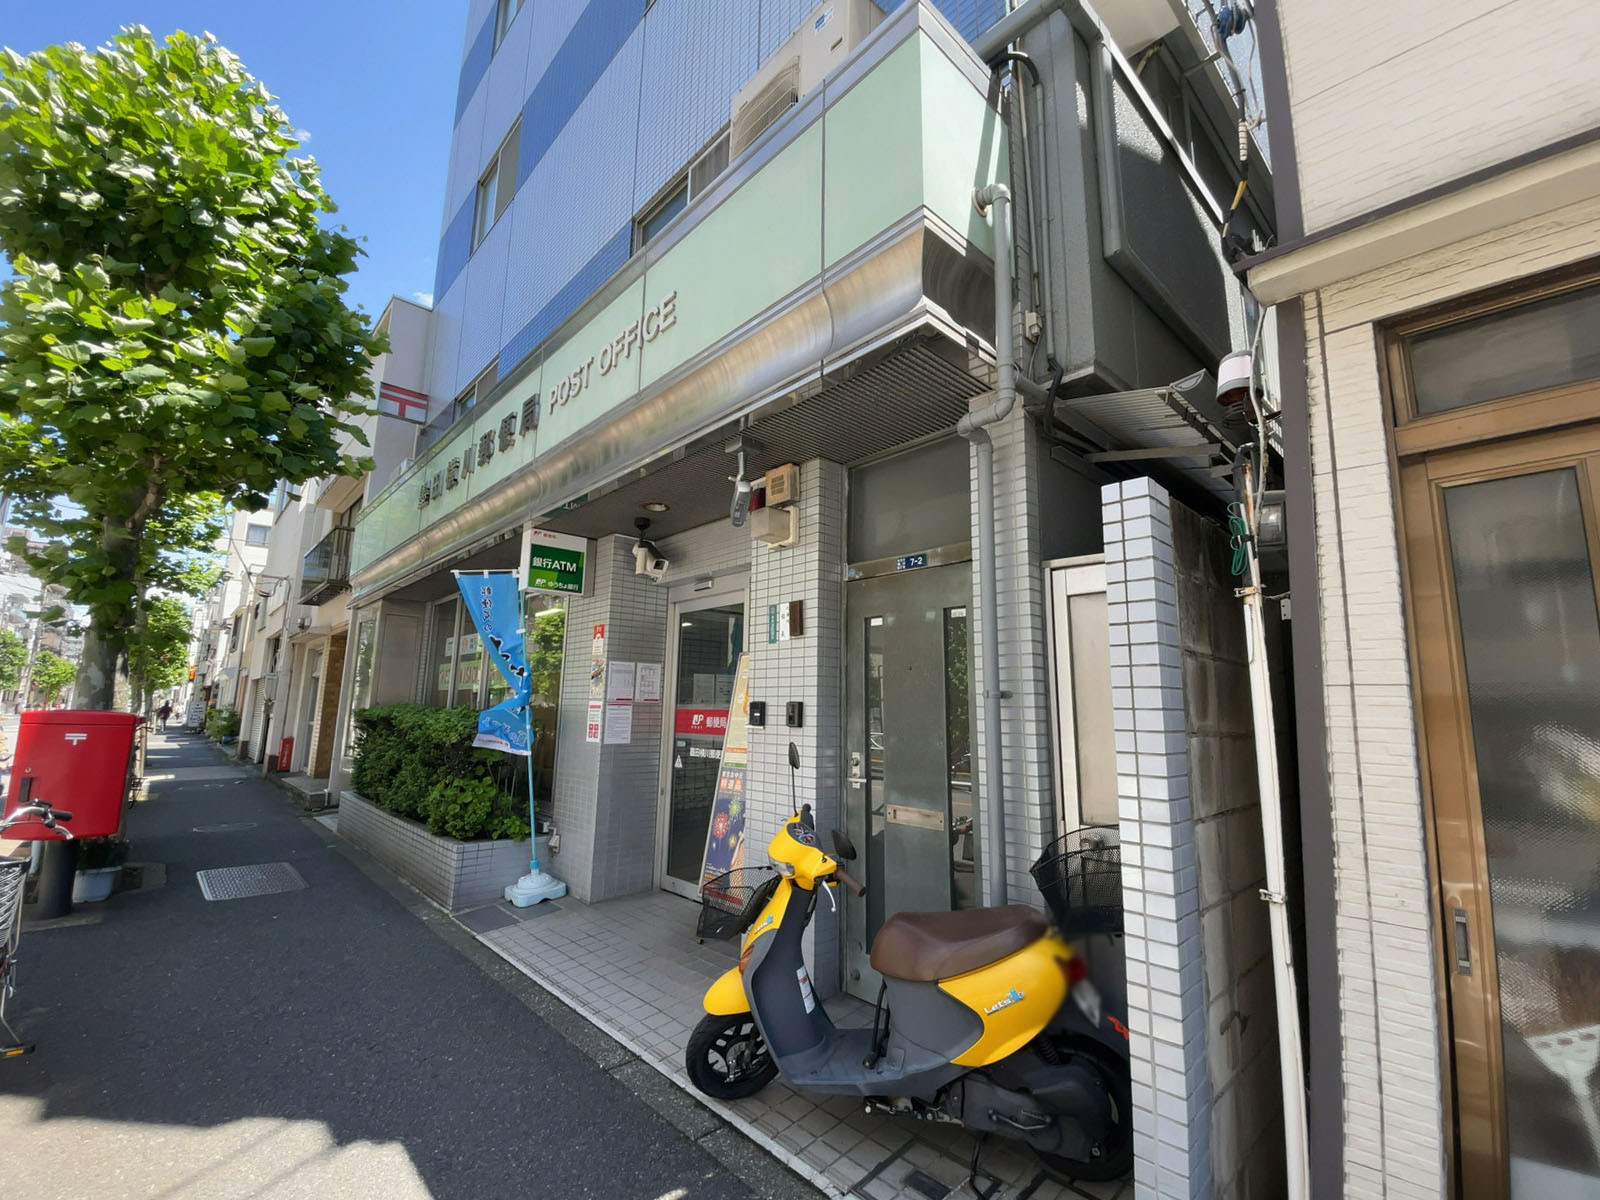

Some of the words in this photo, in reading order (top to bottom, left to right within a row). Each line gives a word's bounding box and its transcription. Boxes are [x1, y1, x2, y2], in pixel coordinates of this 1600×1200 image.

[549, 356, 595, 415] POST
[598, 290, 678, 377] OFFICE
[532, 556, 577, 573] 銀行ATM
[909, 556, 923, 567] 7-2
